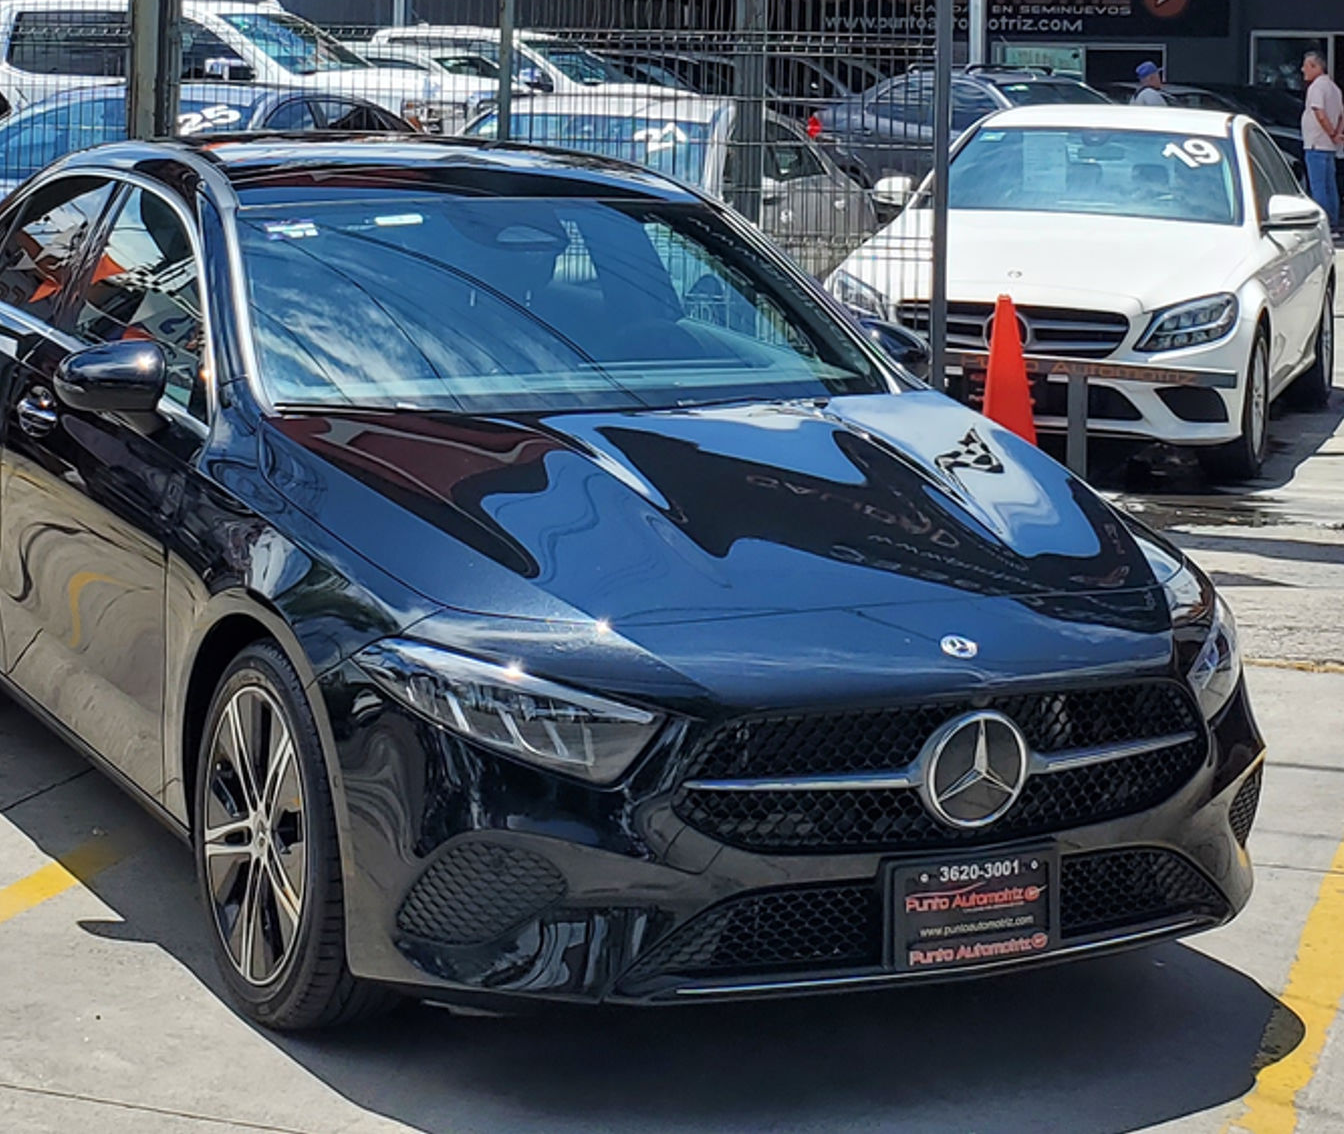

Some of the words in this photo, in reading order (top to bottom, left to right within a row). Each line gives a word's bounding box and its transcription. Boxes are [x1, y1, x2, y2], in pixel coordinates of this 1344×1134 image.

[178, 104, 241, 136] 25
[1162, 139, 1221, 168] 19
[939, 860, 1019, 882] 3620-3001
[906, 895, 950, 913] Punto
[951, 887, 1025, 909] Automotriz
[910, 947, 954, 966] Punto
[956, 937, 1032, 960] Automotriz
